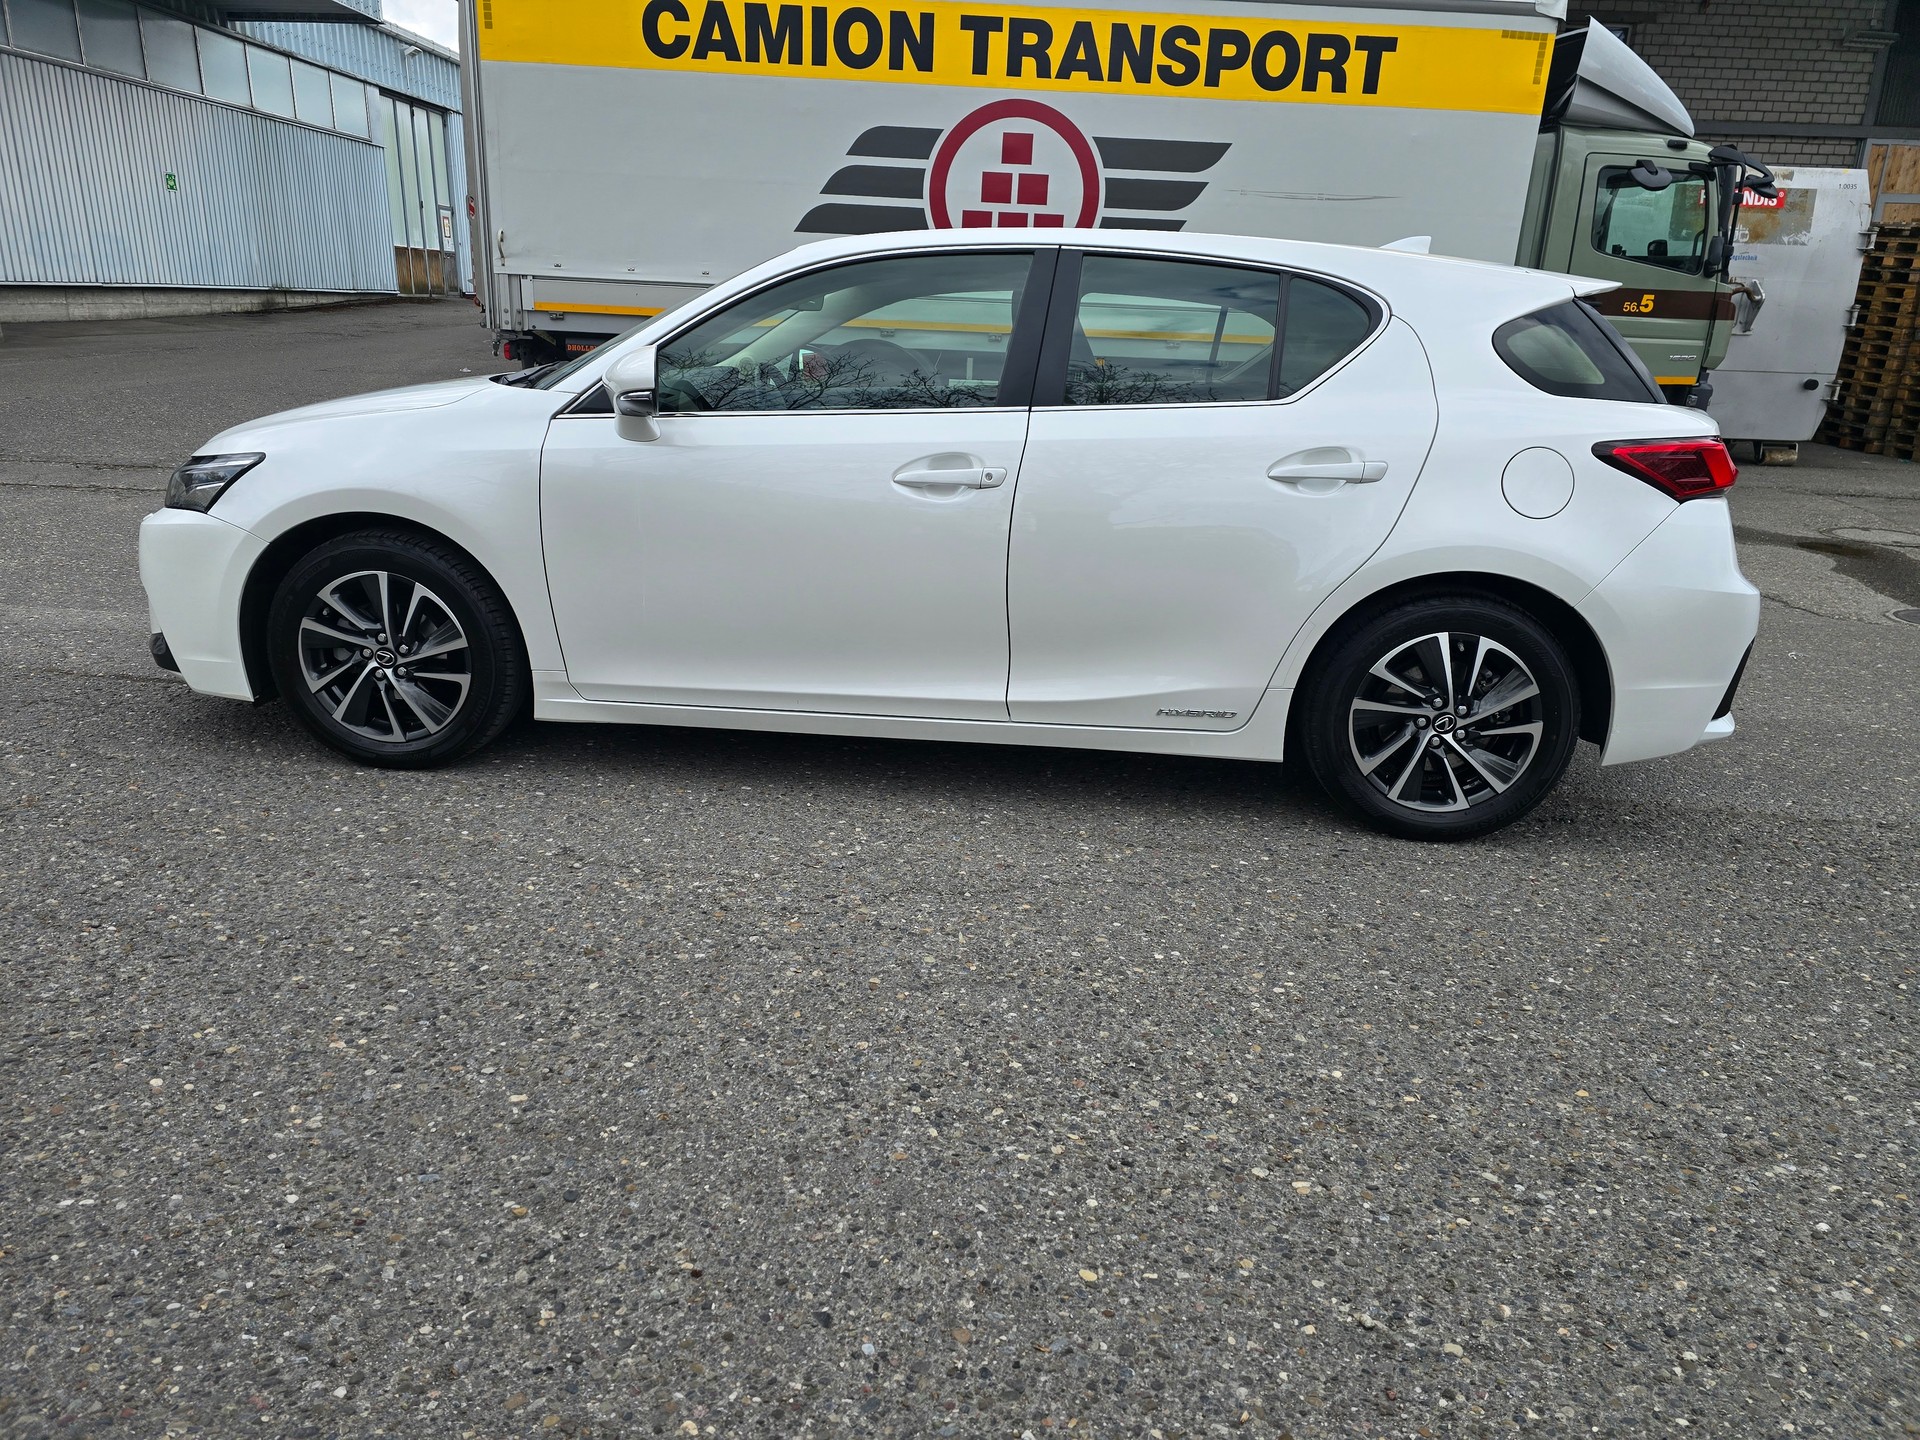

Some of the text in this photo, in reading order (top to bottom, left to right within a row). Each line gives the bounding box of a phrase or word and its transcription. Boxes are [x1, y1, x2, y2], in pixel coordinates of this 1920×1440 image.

[642, 0, 1399, 95] CAMION TRANSPORT
[1622, 294, 1655, 313] 56.5
[1156, 708, 1238, 719] HYBRID
